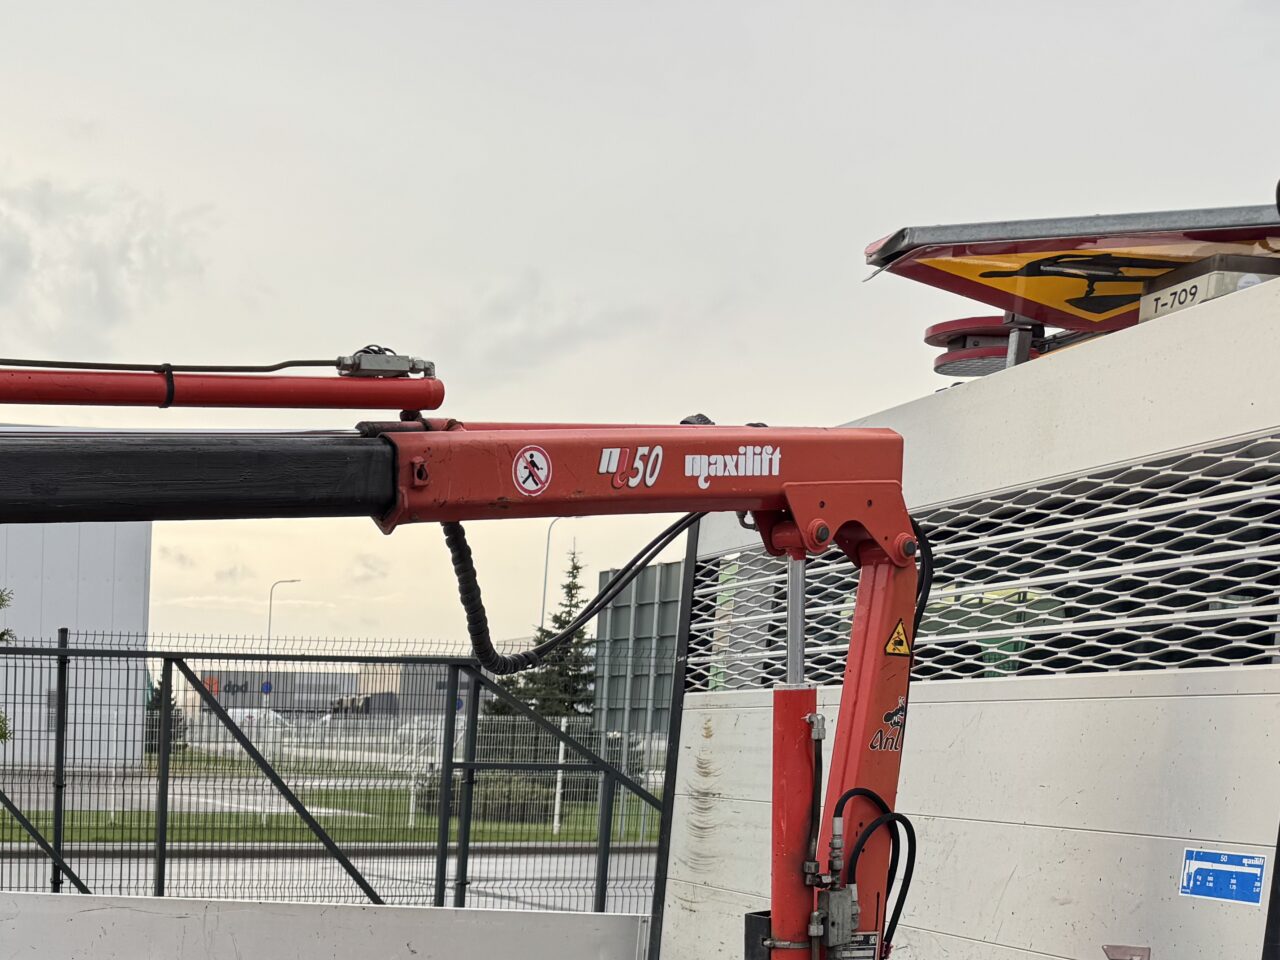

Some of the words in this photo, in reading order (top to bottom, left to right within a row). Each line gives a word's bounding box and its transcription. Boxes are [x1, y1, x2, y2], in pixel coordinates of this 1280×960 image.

[1153, 284, 1199, 314] T-709
[684, 445, 782, 490] maxilift
[224, 680, 249, 696] dpd
